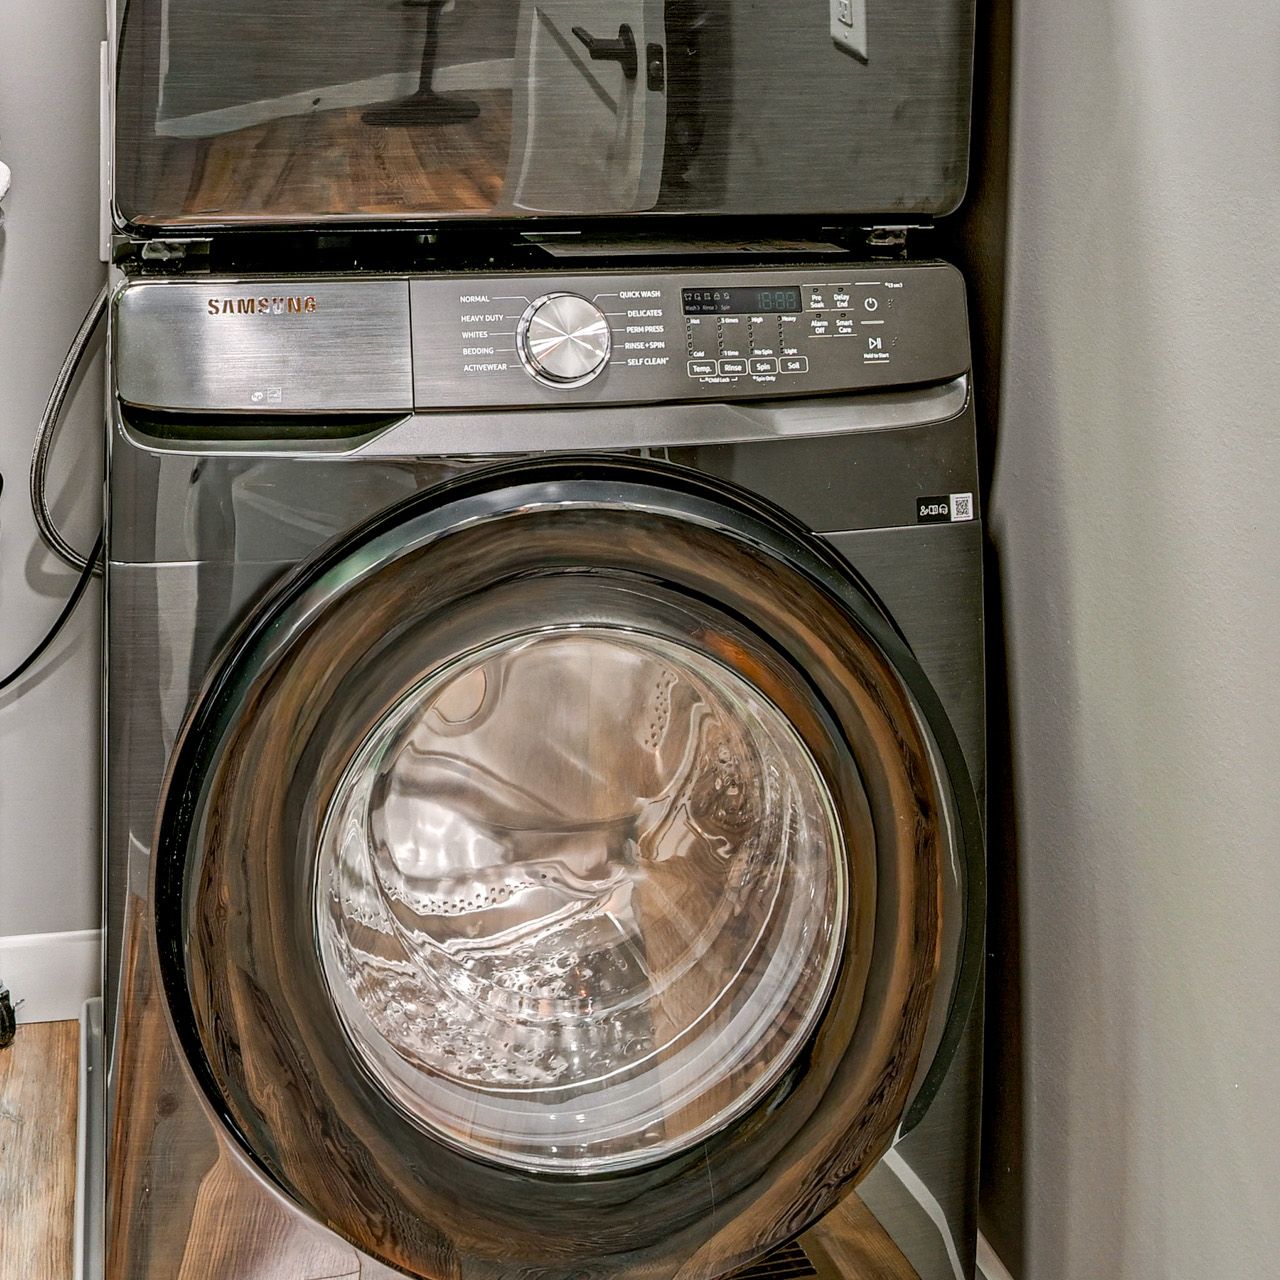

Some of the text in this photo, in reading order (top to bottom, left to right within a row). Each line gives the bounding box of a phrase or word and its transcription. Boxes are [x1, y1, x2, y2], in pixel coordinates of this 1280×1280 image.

[619, 290, 661, 299] QUICK WASH
[460, 295, 490, 303] NORMAL
[207, 296, 317, 315] SAMSUNG
[810, 301, 825, 309] Soak
[837, 300, 848, 308] End
[627, 309, 663, 318] DELICATES
[461, 314, 504, 322] HEAVY DUTY
[626, 325, 664, 334] PERM PRESS
[814, 326, 825, 334] Off
[838, 326, 852, 334] Care
[461, 331, 488, 339] WHITES
[462, 347, 494, 355] BEDDING
[627, 358, 644, 366] SELF
[787, 361, 800, 370] Soil
[463, 363, 507, 372] ACTIVEWEAR
[692, 365, 713, 374] Temp.
[724, 364, 742, 372] Rinse
[756, 362, 771, 372] Spin
